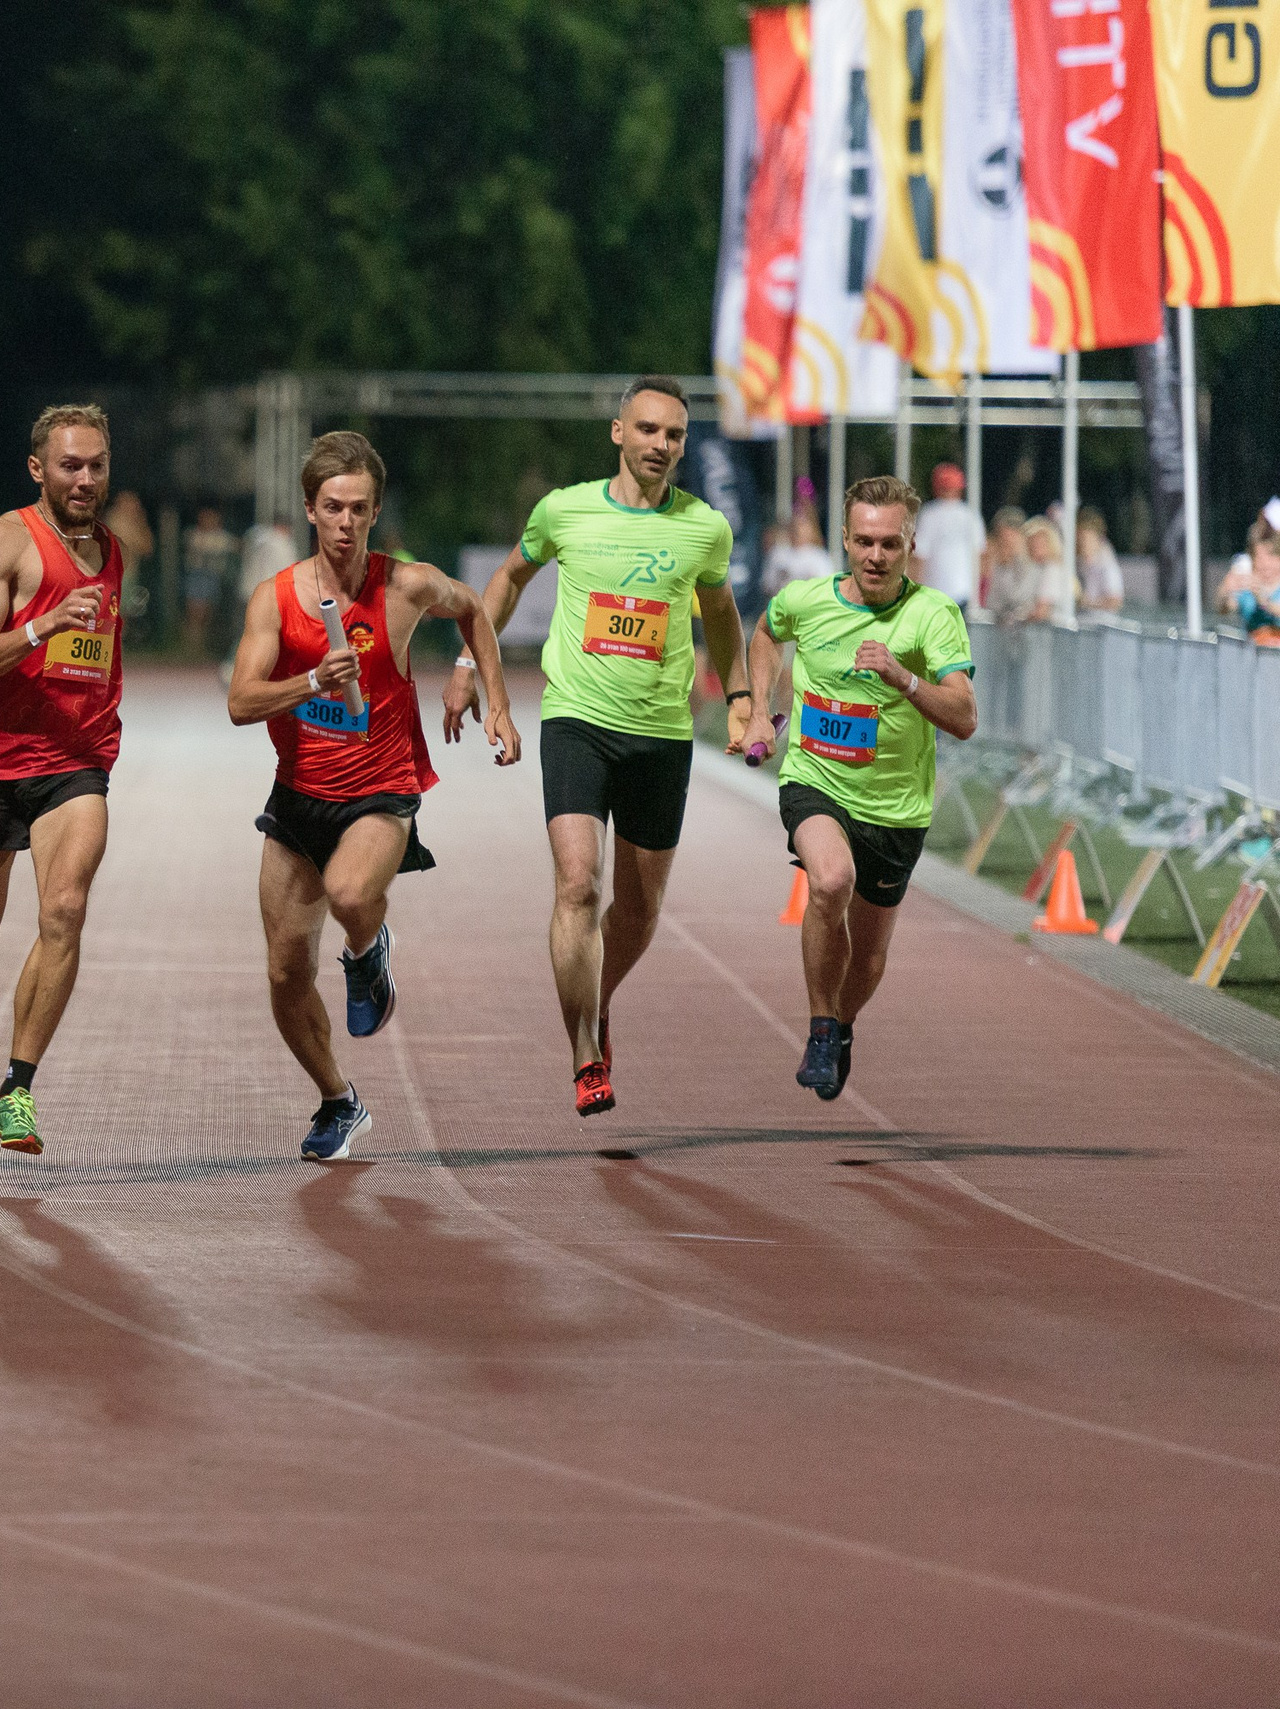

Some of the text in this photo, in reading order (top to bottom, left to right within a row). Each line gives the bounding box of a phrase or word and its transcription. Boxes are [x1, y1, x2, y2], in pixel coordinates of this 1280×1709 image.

[608, 614, 658, 641] 307 2
[70, 637, 109, 662] 308 2
[306, 701, 359, 727] 308 3
[819, 717, 868, 743] 307 3
